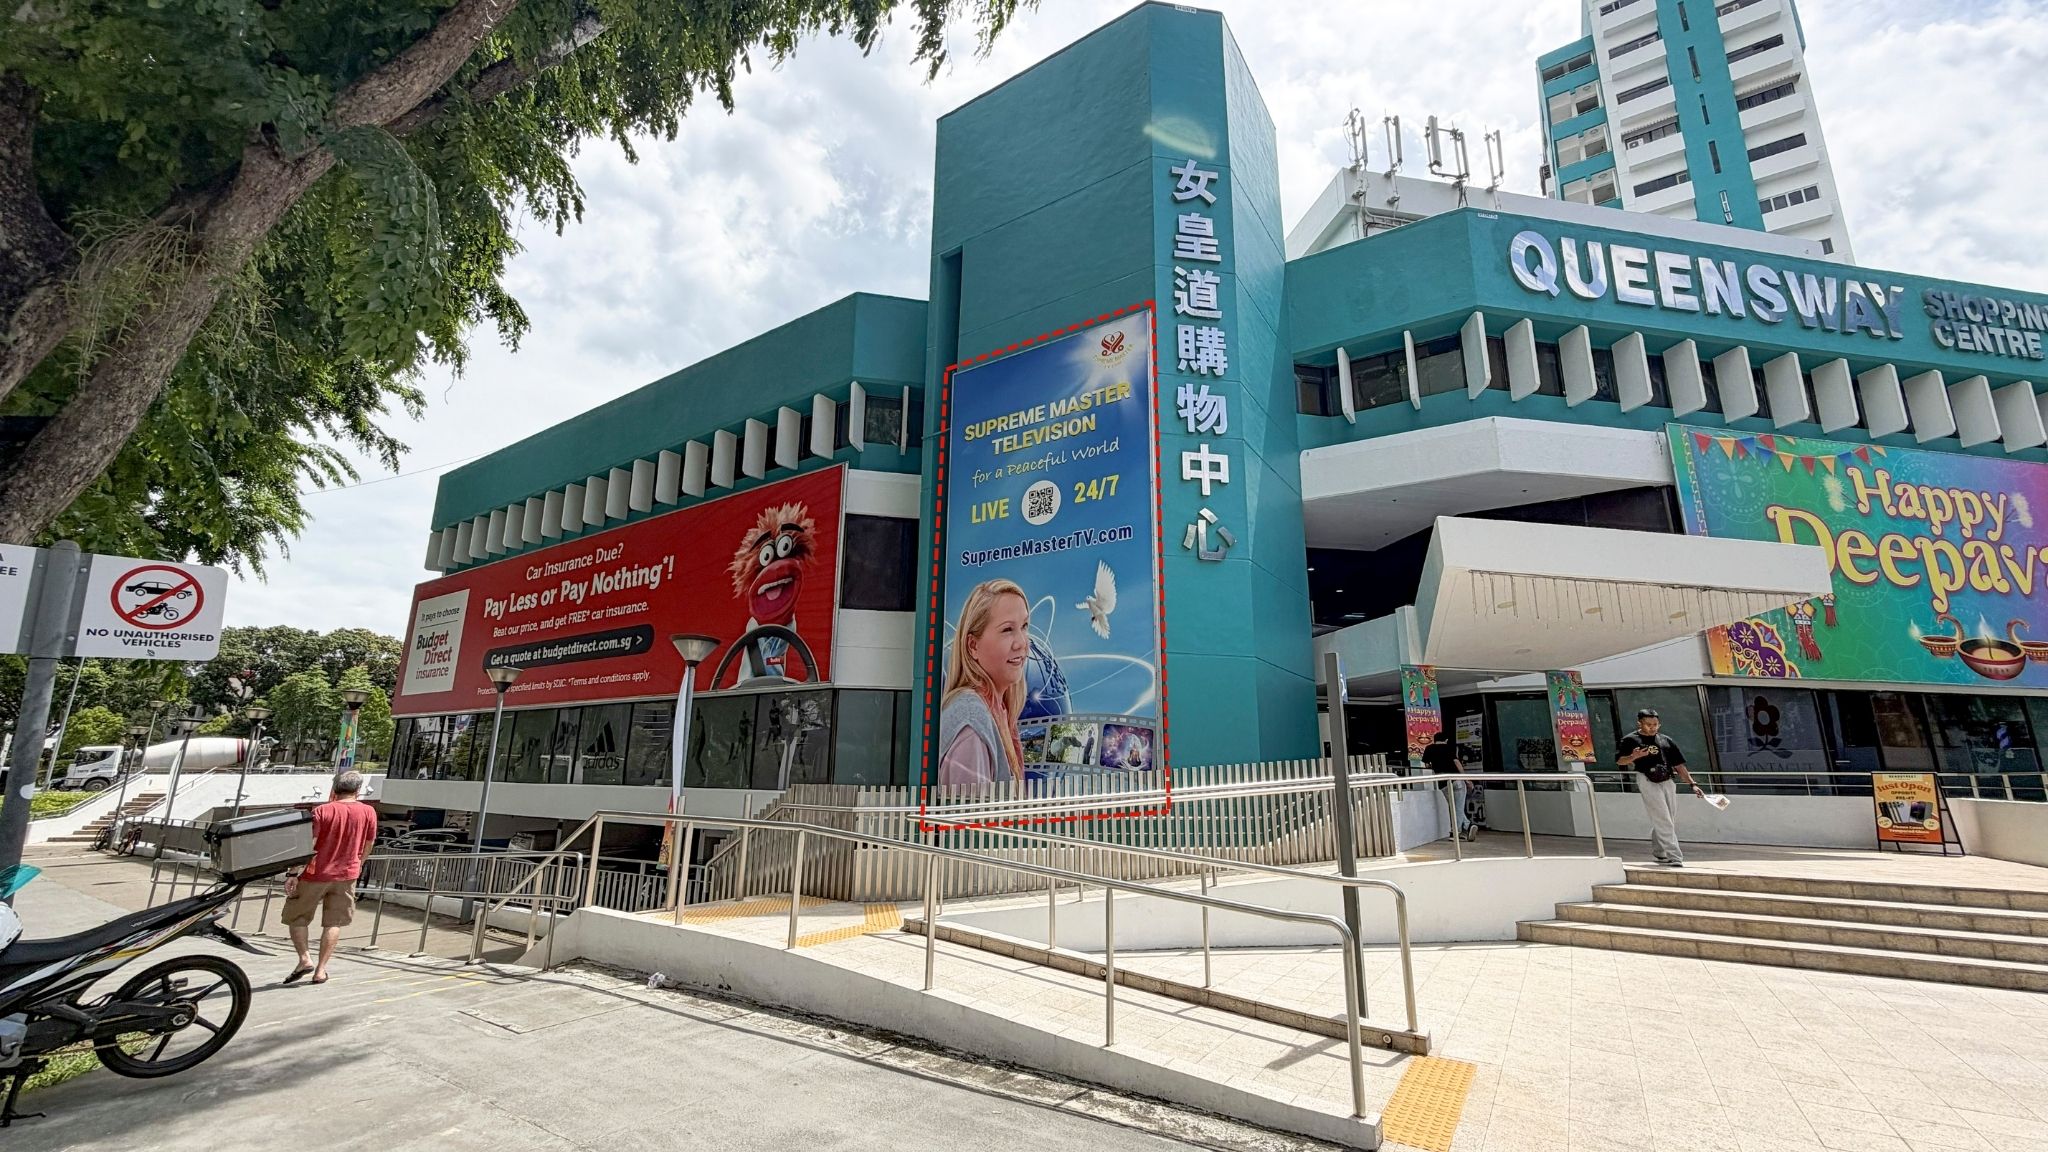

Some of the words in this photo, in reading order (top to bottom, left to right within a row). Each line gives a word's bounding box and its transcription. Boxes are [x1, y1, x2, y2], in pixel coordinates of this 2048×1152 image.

[1508, 230, 1904, 340] QUEENSWAY
[1931, 318, 2045, 360] CENTRE
[1171, 159, 1236, 561] 女皇道購物中心
[964, 404, 1046, 442] SUPREME
[1049, 382, 1132, 419] MASTER
[992, 413, 1097, 455] TELEVISION
[972, 468, 990, 489] for
[996, 468, 1004, 479] a
[1007, 453, 1068, 476] Peaceful
[1072, 436, 1120, 461] World
[971, 498, 1010, 524] LIVE
[1074, 475, 1120, 503] 24/7
[1846, 467, 2008, 542] Happy
[526, 565, 542, 581] Car
[544, 553, 593, 578] Insurance
[595, 542, 624, 564] Due?
[961, 525, 1133, 567] SupremeMasterTV.com
[425, 611, 437, 622] pays
[436, 610, 442, 619] to
[442, 607, 460, 618] choose
[483, 598, 508, 621] Pay
[509, 592, 538, 613] Less
[540, 587, 557, 606] or
[560, 580, 589, 604] Pay
[493, 626, 507, 638] Beat
[507, 624, 519, 636] our
[520, 621, 539, 635] price,
[540, 617, 554, 629] and
[554, 615, 567, 630] get
[591, 609, 604, 621] car
[605, 600, 650, 618] insurance.
[86, 628, 109, 637] NO
[113, 629, 215, 642] UNAUTHORISED
[121, 638, 182, 649] VEHICLES
[416, 630, 449, 651] Budget
[490, 653, 503, 666] Get
[503, 656, 509, 664] a
[509, 649, 532, 666] quote
[532, 648, 542, 660] at
[543, 634, 633, 660] budgetdirect.com.sg
[415, 665, 449, 680] insurance
[424, 646, 452, 665] Direct
[588, 674, 599, 685] and
[599, 672, 631, 685] conditions
[1877, 782, 1900, 793] Just
[1901, 781, 1932, 793] Open
